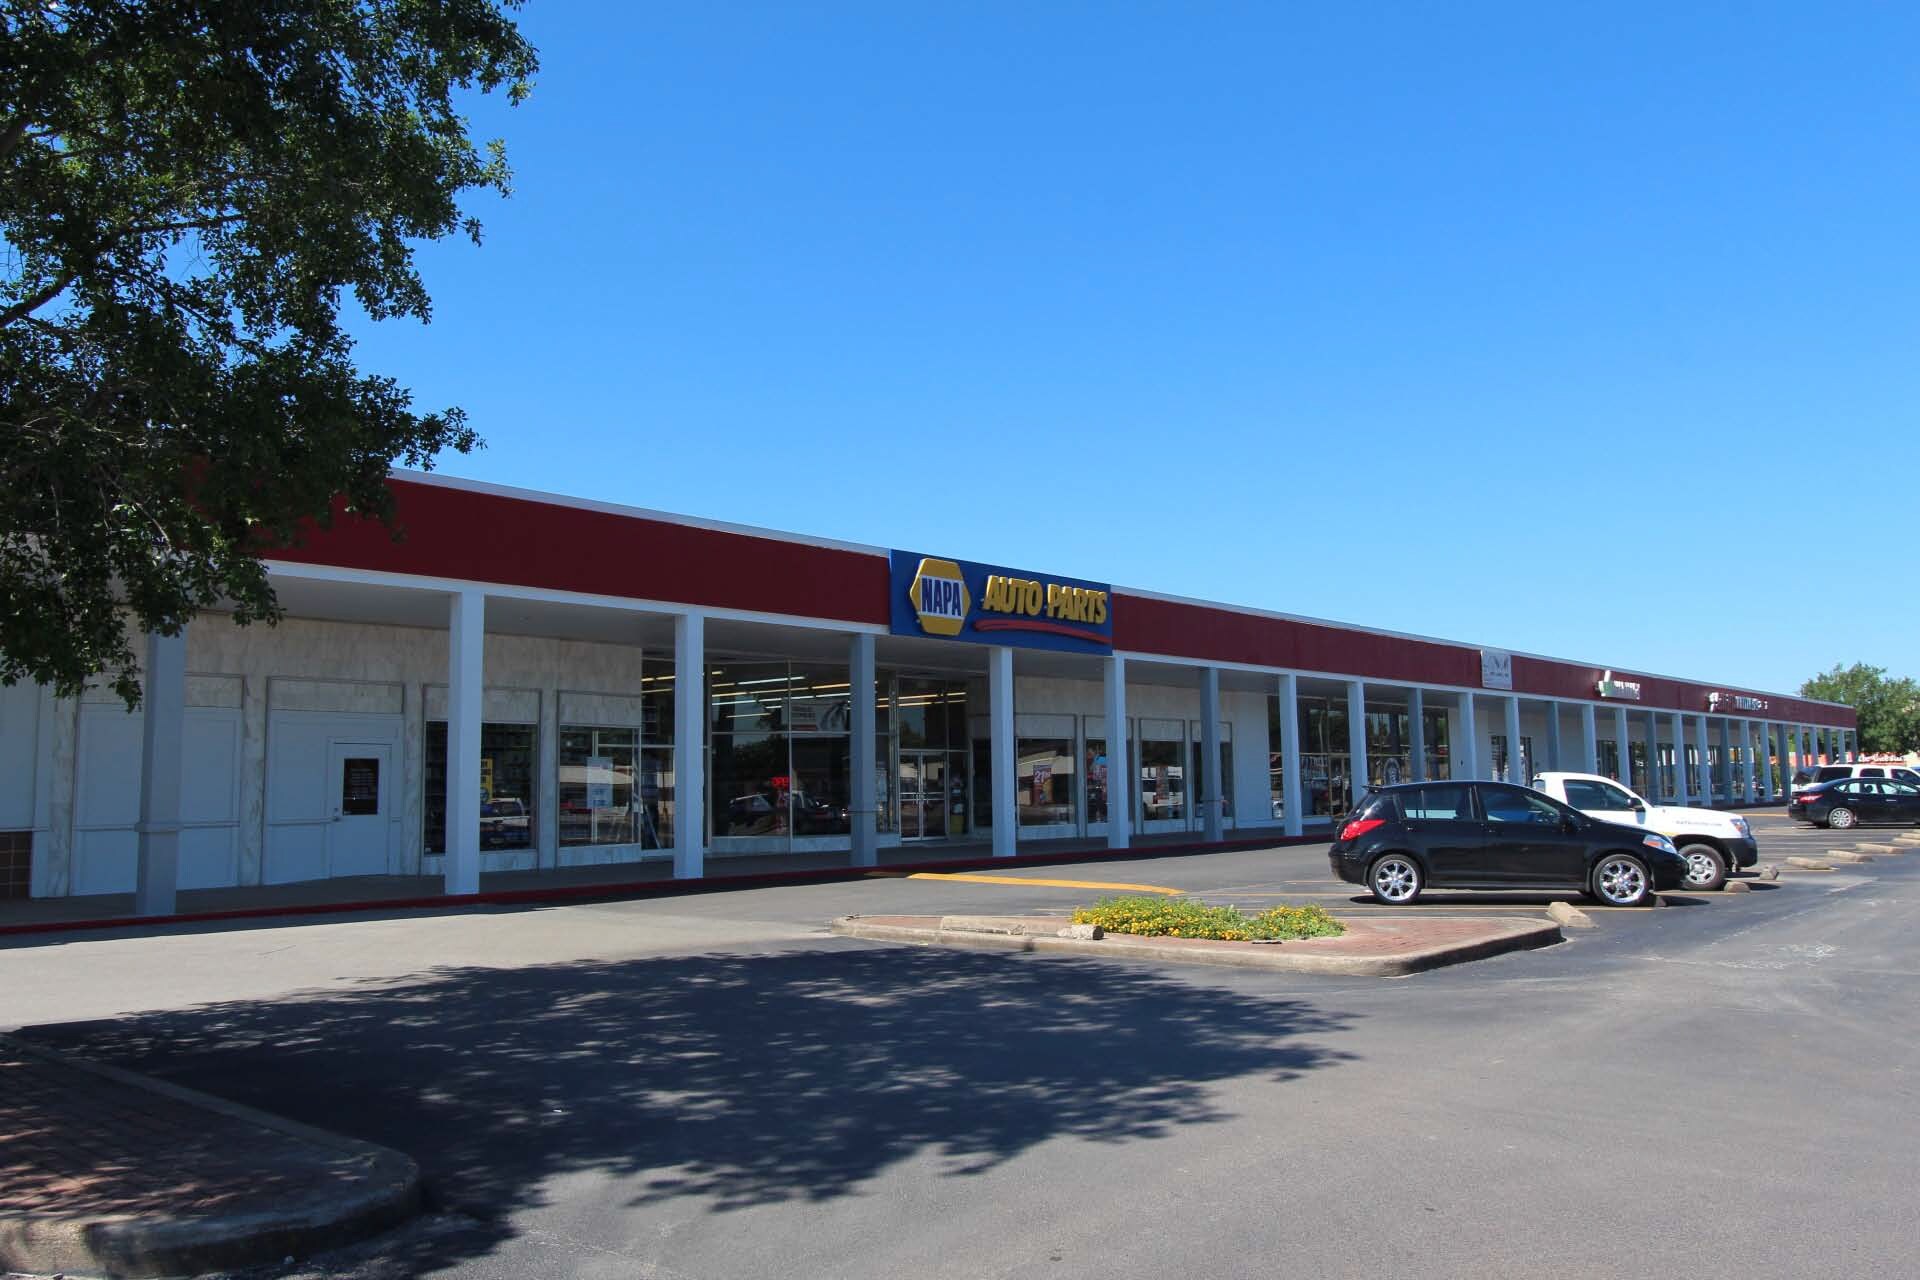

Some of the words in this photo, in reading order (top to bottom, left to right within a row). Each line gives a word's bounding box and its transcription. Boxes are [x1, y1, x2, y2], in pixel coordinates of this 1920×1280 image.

[921, 576, 962, 617] NAPA
[983, 575, 1043, 616] AUTO
[1046, 583, 1108, 625] PARTS
